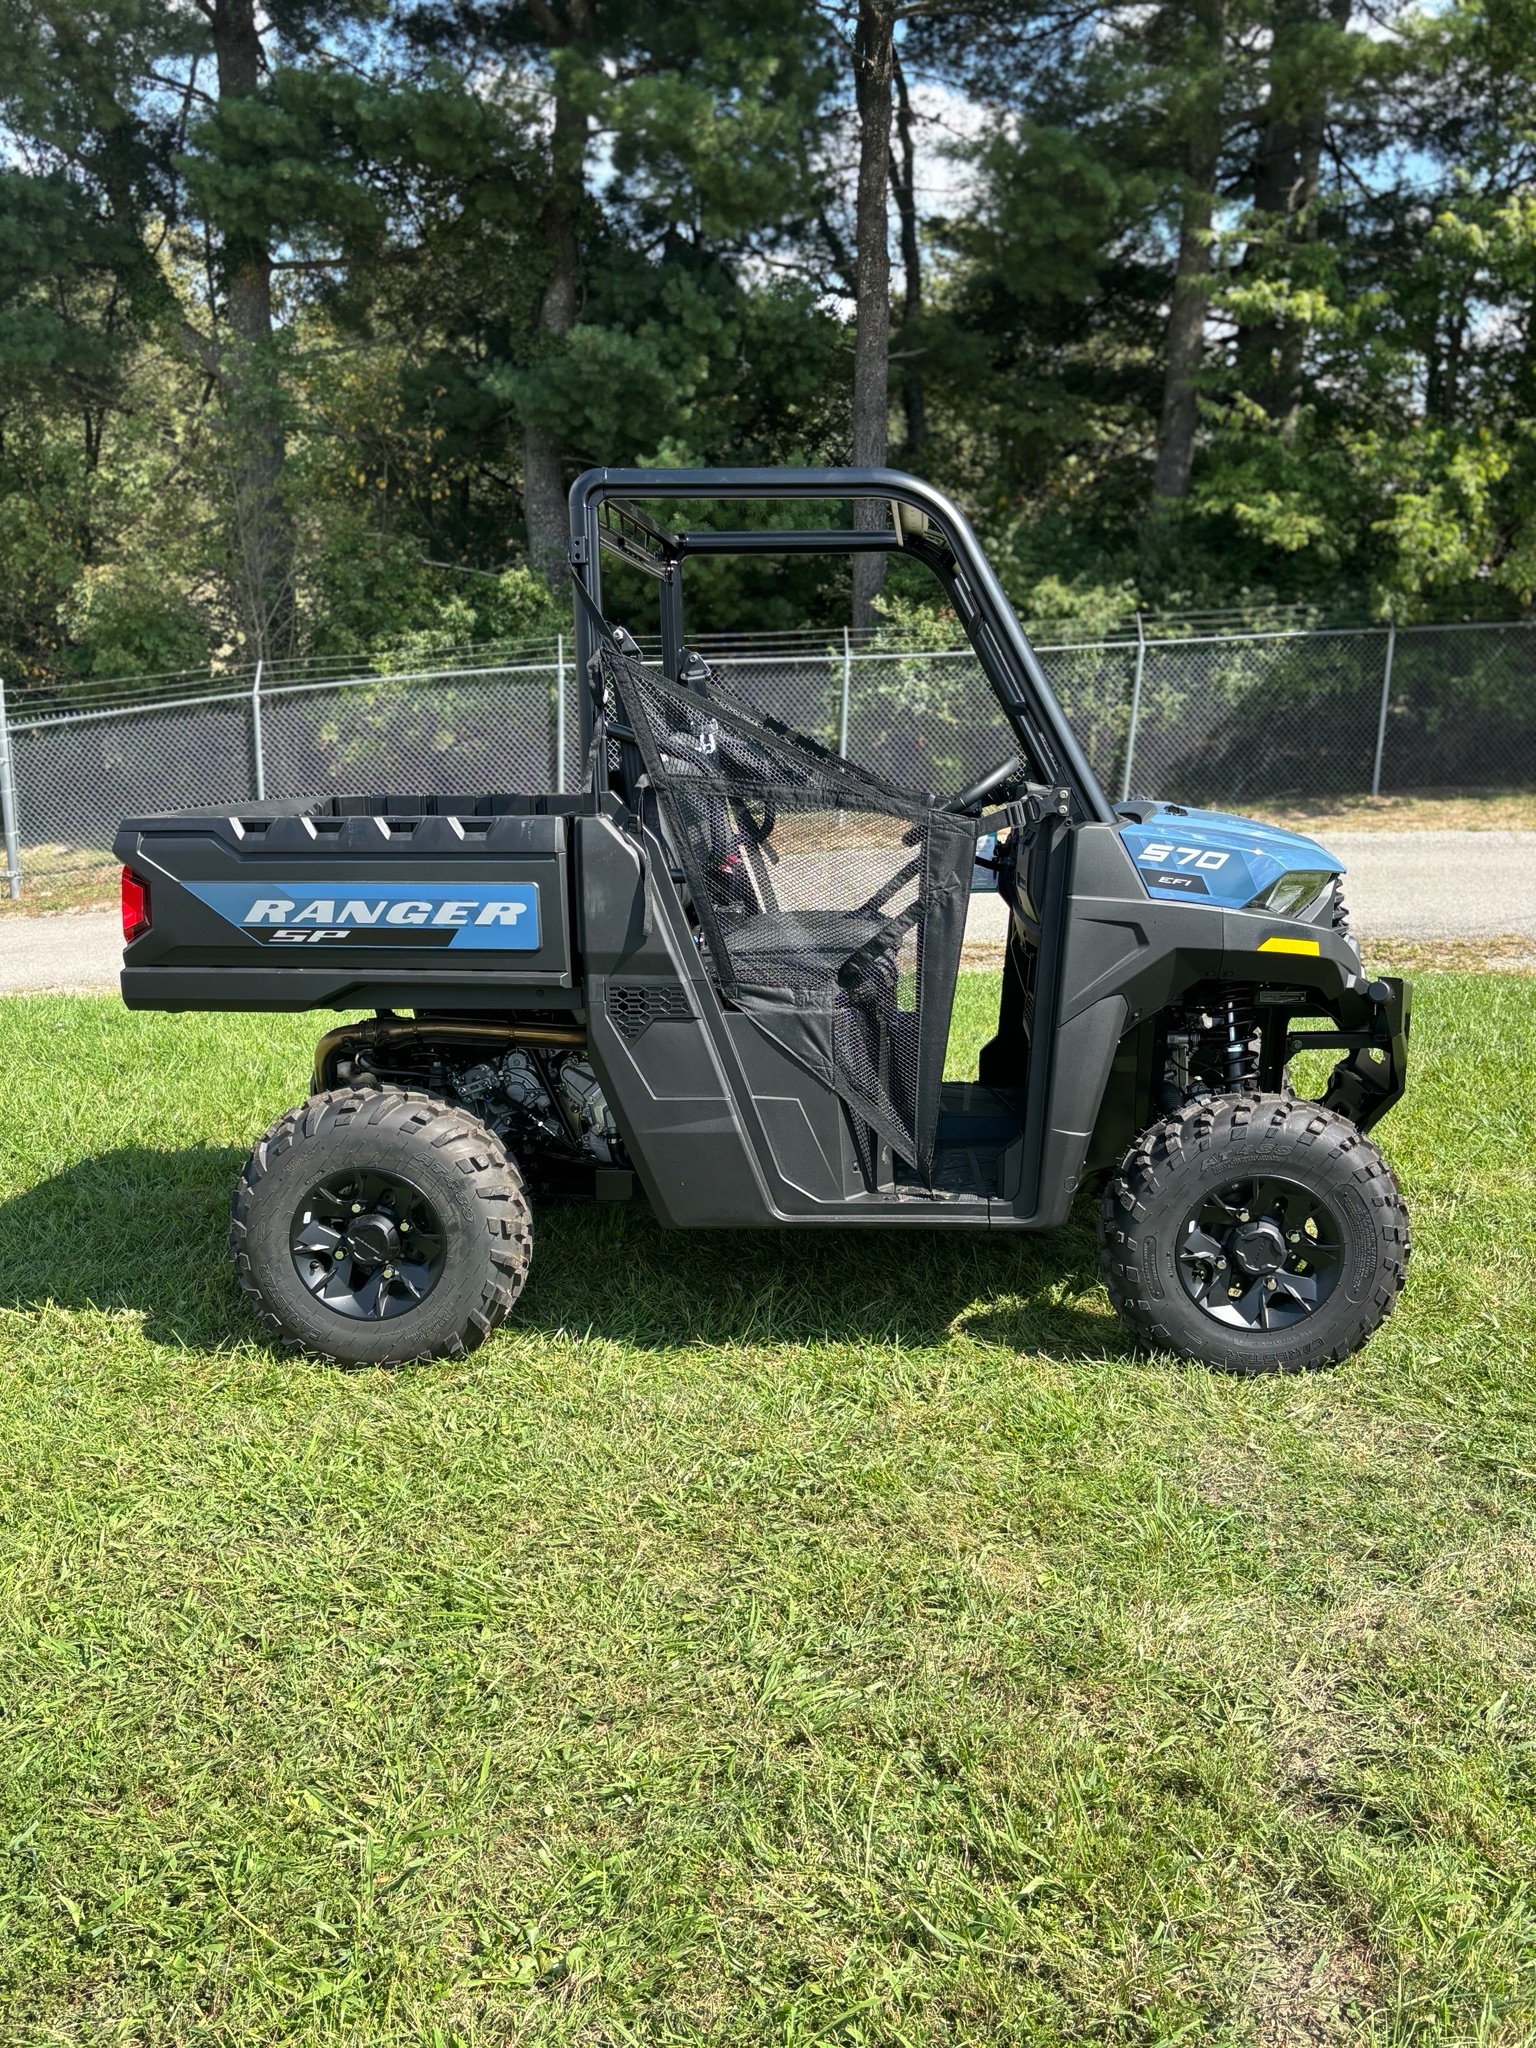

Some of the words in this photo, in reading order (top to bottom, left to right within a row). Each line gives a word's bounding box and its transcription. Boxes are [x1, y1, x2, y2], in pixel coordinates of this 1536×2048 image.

[1138, 843, 1230, 870] 570
[1158, 876, 1192, 887] EFI
[243, 899, 527, 926] RANGER
[268, 930, 350, 943] SP
